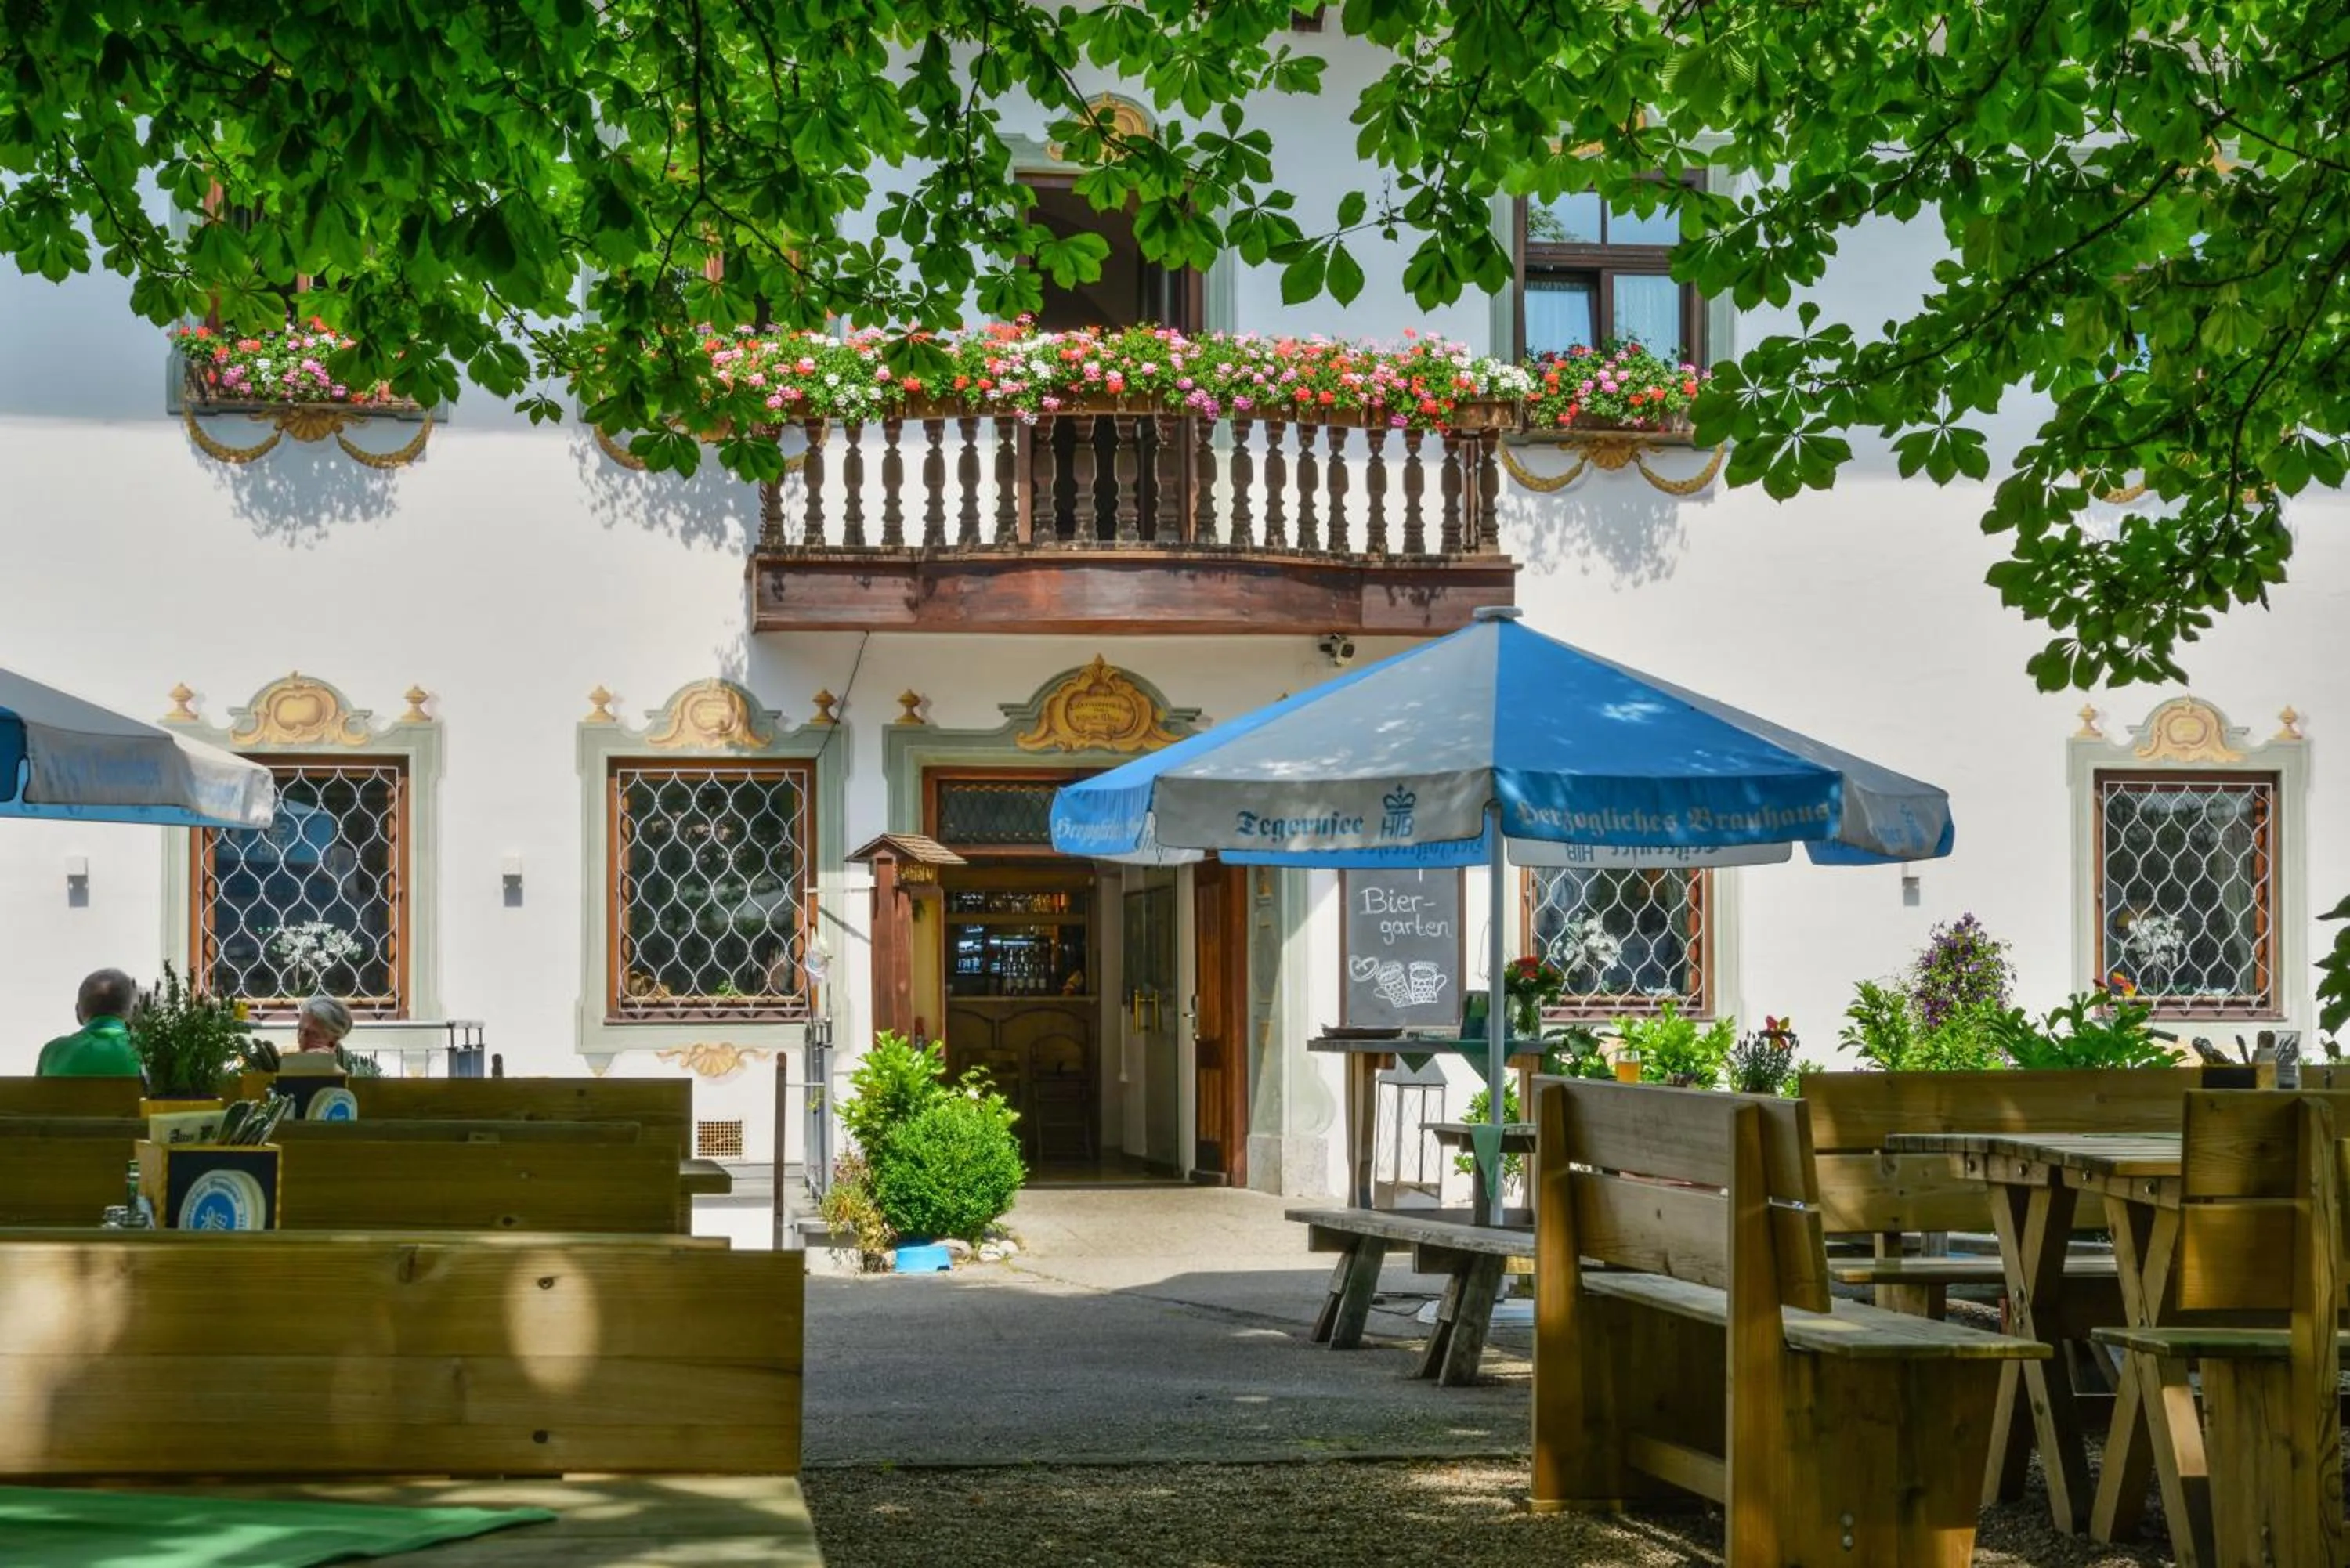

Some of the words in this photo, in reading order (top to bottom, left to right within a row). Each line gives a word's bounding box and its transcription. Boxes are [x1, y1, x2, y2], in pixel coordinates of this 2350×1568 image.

[1515, 798, 1679, 836] Herzogliches
[1687, 800, 1831, 833] Brauhaus
[1359, 887, 1437, 915] Bier-
[1379, 914, 1453, 946] garten
